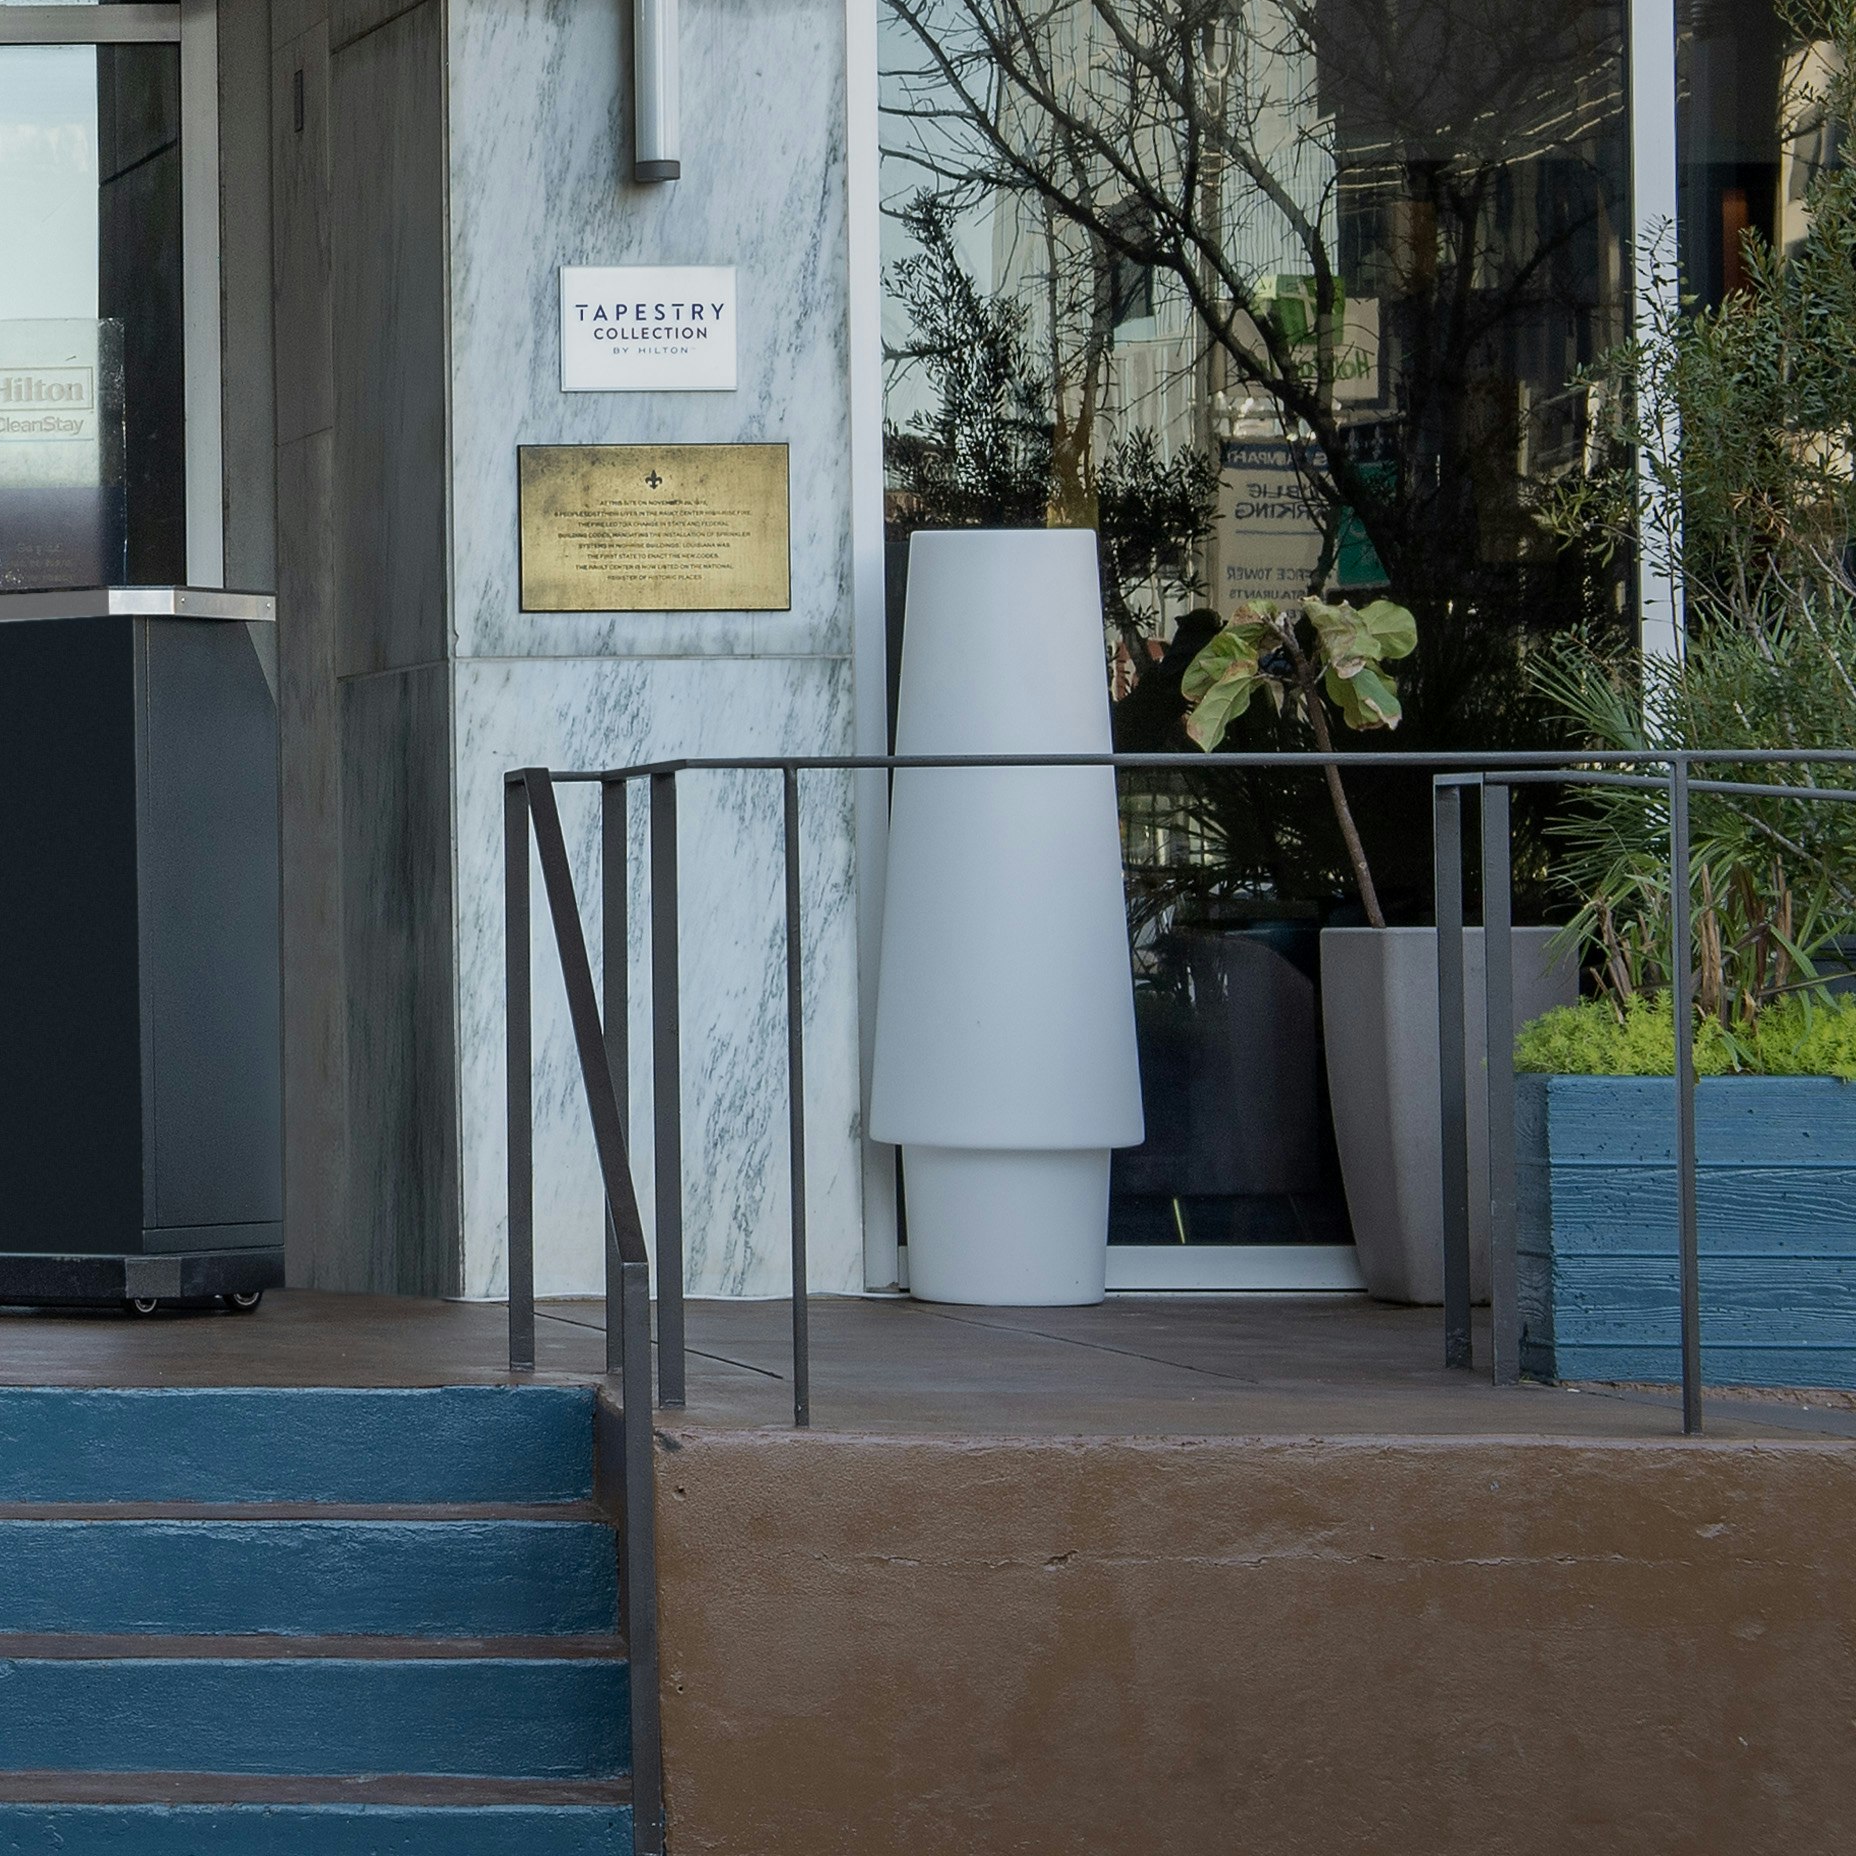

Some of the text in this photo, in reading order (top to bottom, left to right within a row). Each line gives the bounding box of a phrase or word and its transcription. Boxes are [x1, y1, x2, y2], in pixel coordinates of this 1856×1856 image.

[575, 303, 724, 321] TAPESTRY
[593, 327, 707, 340] COLLECTION
[638, 346, 689, 354] HILTON
